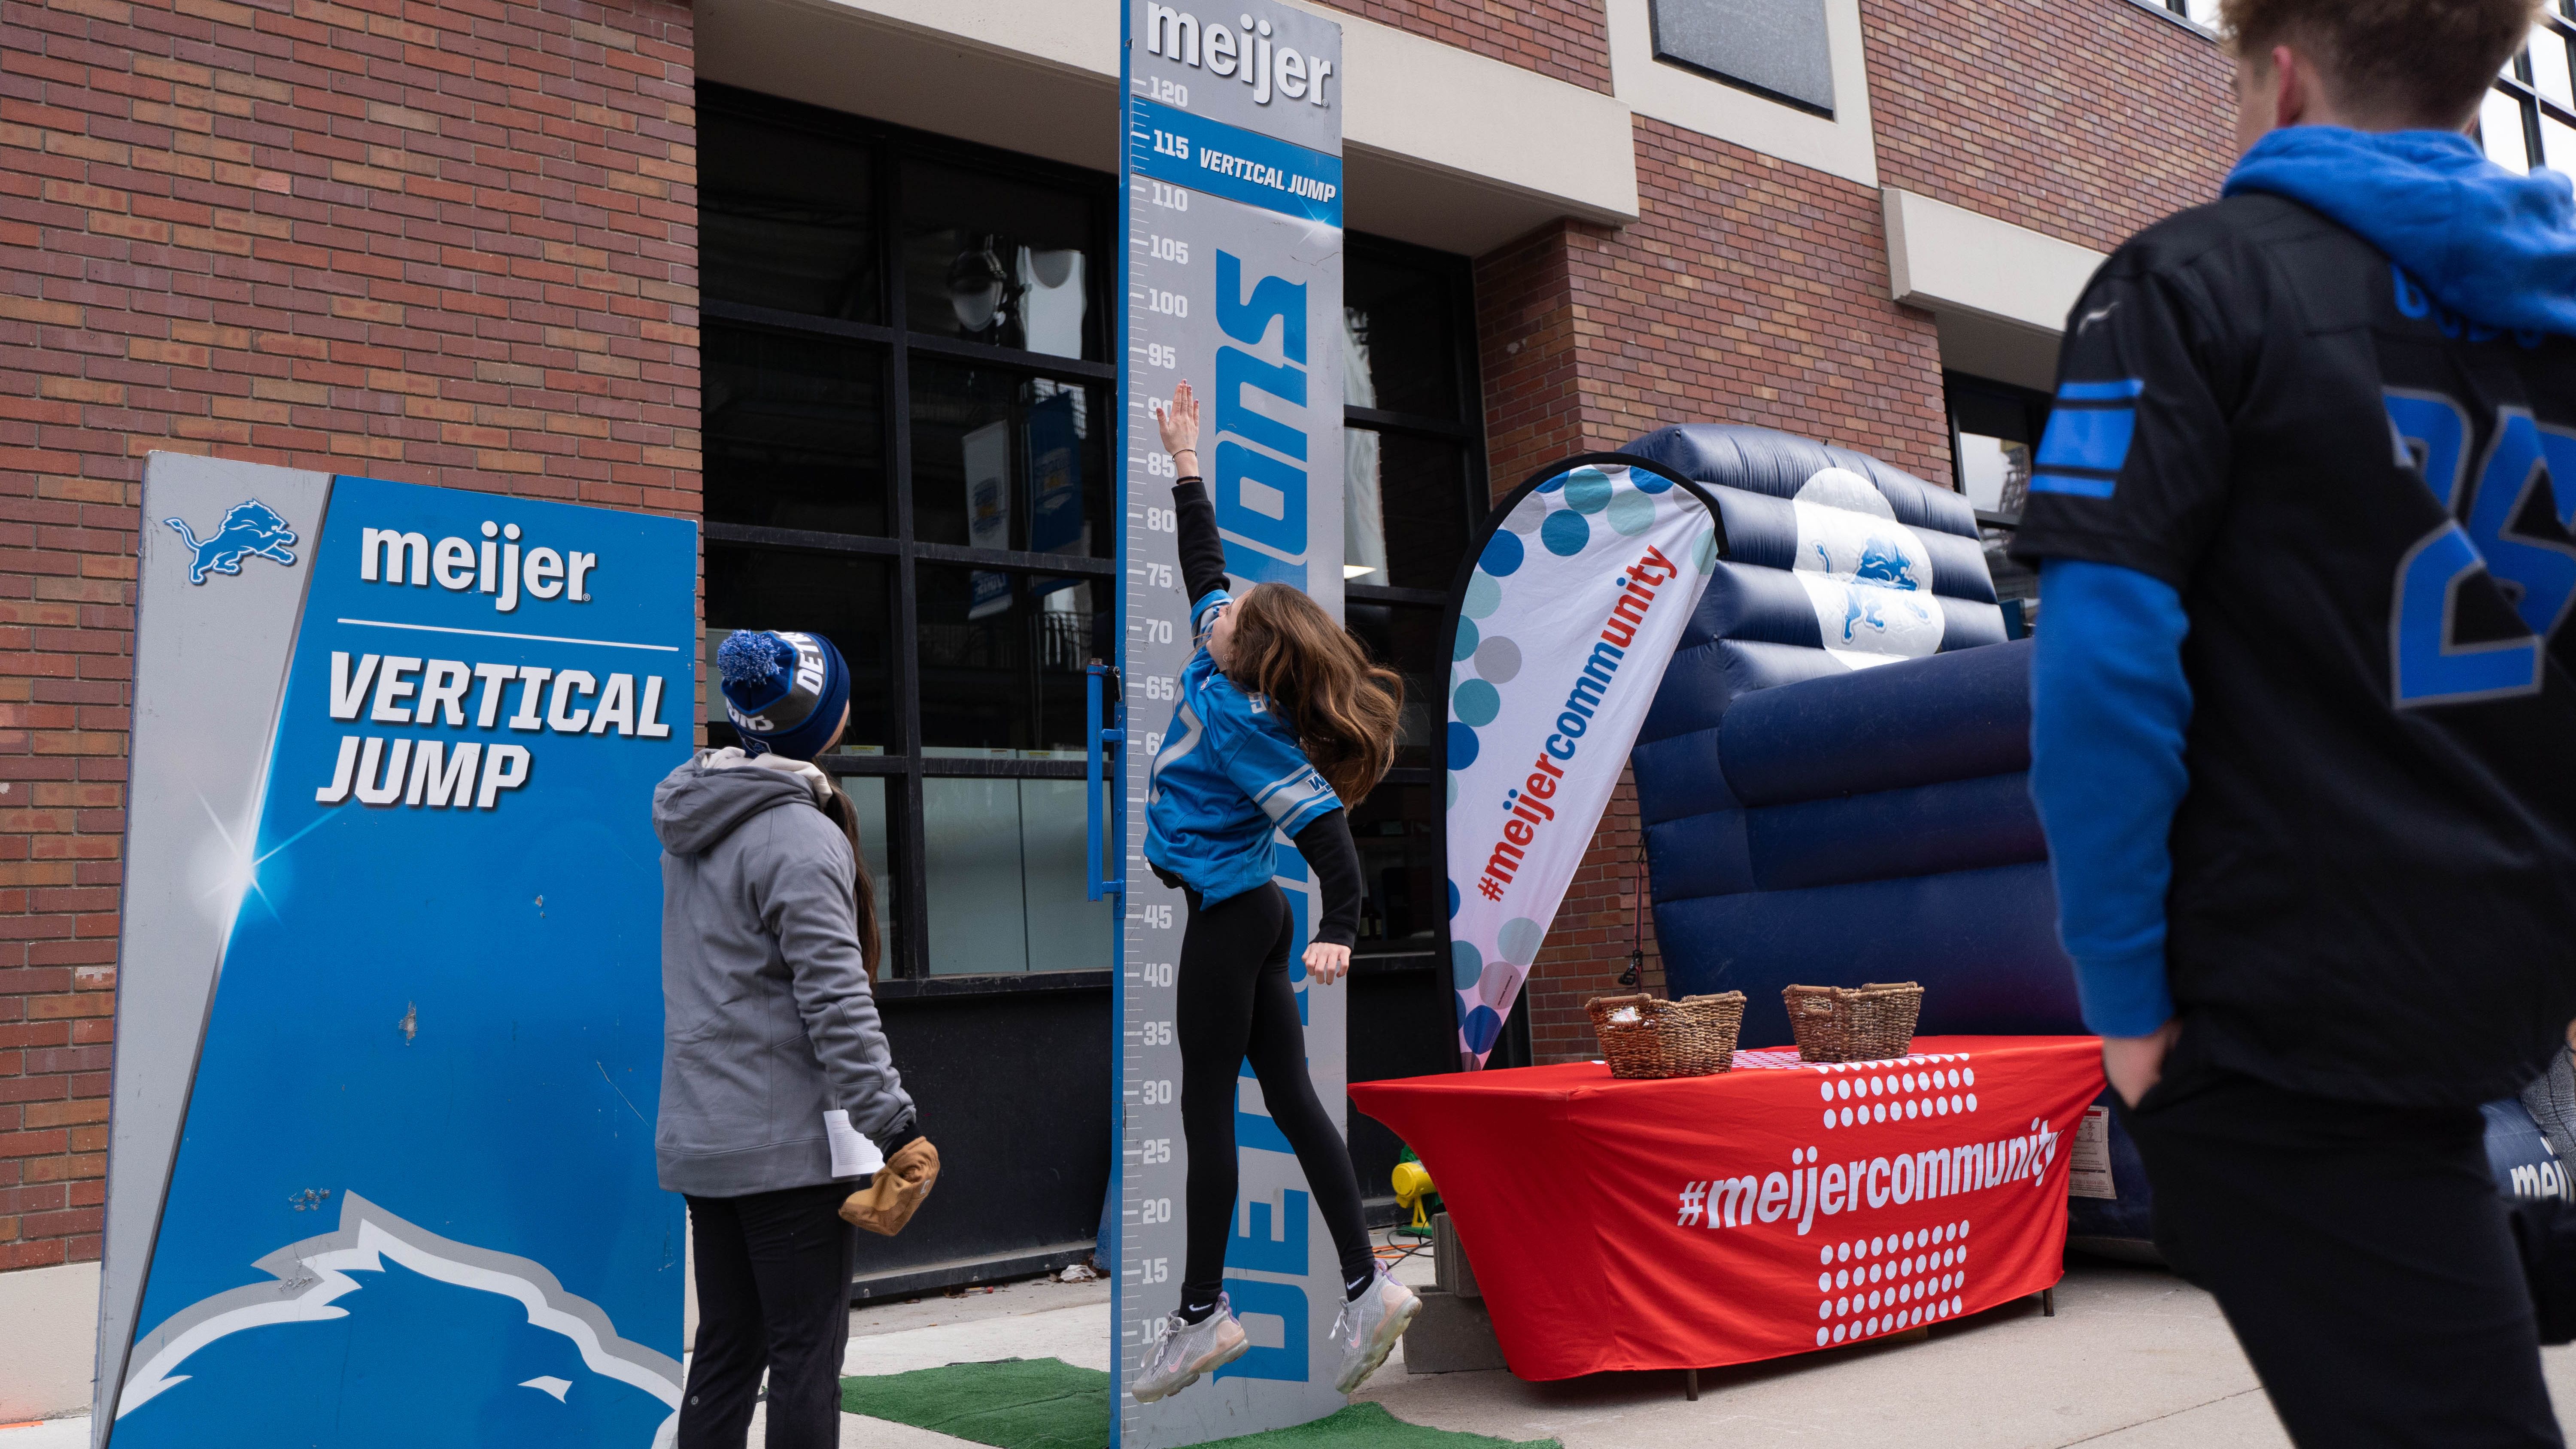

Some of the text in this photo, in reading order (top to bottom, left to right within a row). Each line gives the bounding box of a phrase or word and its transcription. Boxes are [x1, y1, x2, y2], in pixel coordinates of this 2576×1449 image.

[1147, 1, 1331, 104] meijer
[1150, 76, 1188, 107] 120
[1154, 129, 1189, 160] 115
[1200, 148, 1336, 203] VERTICAL JUMP
[1152, 182, 1188, 212] 110
[1150, 234, 1188, 265] 105
[1149, 288, 1188, 318] 100
[1148, 343, 1176, 369] 95
[1215, 248, 1307, 597] IONS
[1148, 452, 1175, 478] 85
[1147, 507, 1176, 533] 80
[361, 521, 595, 612] meijer
[1146, 562, 1173, 588] 75
[1146, 618, 1173, 644] 70
[329, 651, 670, 737] VERTICAL
[1146, 675, 1174, 701] 65
[1477, 544, 1678, 902] #meijercommunity
[1145, 732, 1166, 756] 6
[315, 735, 531, 808] JUMP
[1144, 905, 1172, 929] 45
[1143, 963, 1173, 987] 40
[1143, 1021, 1171, 1046] 35
[1143, 1080, 1172, 1105] 30
[1143, 1138, 1170, 1164] 25
[1677, 1117, 2064, 1235] #meijercommunity
[1142, 1198, 1171, 1224] 20
[1142, 1258, 1168, 1284] 15
